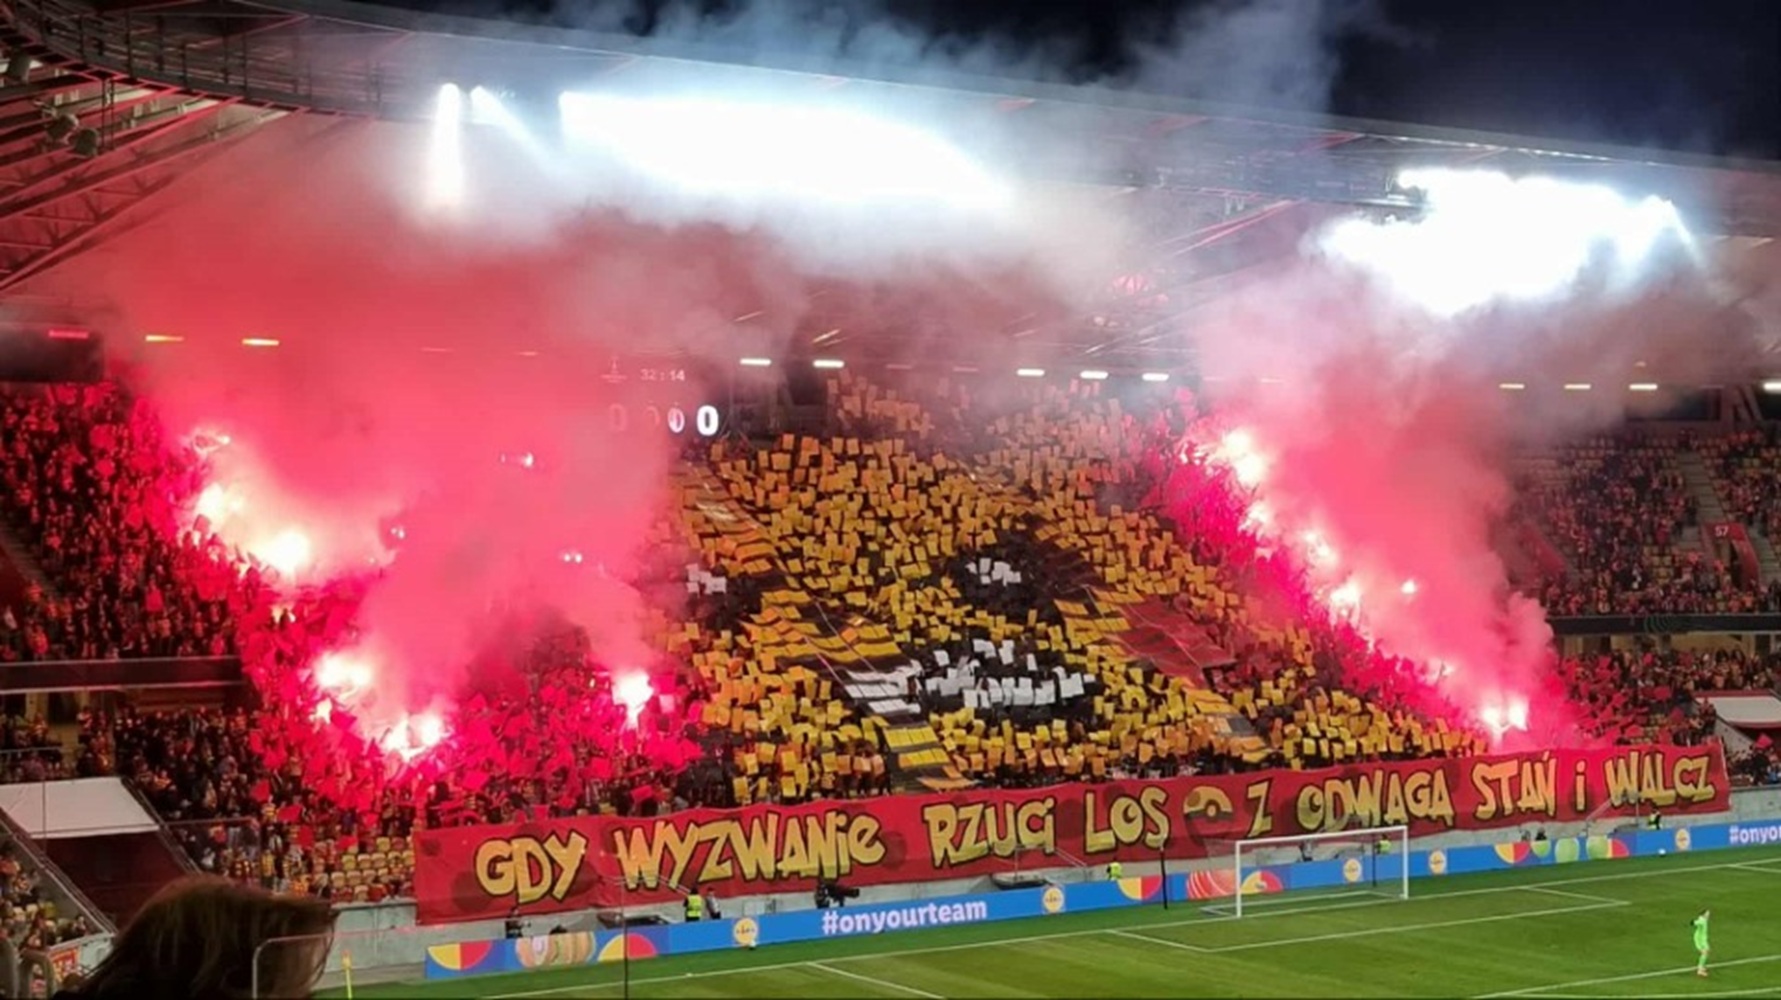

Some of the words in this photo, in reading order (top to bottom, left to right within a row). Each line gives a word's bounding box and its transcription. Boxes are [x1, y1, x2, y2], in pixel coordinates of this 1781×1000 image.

[697, 405, 719, 435] 0
[474, 830, 588, 903] GDY
[1085, 785, 1170, 854] LOS
[1247, 778, 1274, 839] Z
[1471, 751, 1557, 821] STAŃ
[1604, 749, 1716, 807] WALCZ
[822, 900, 987, 935] #onyourteam
